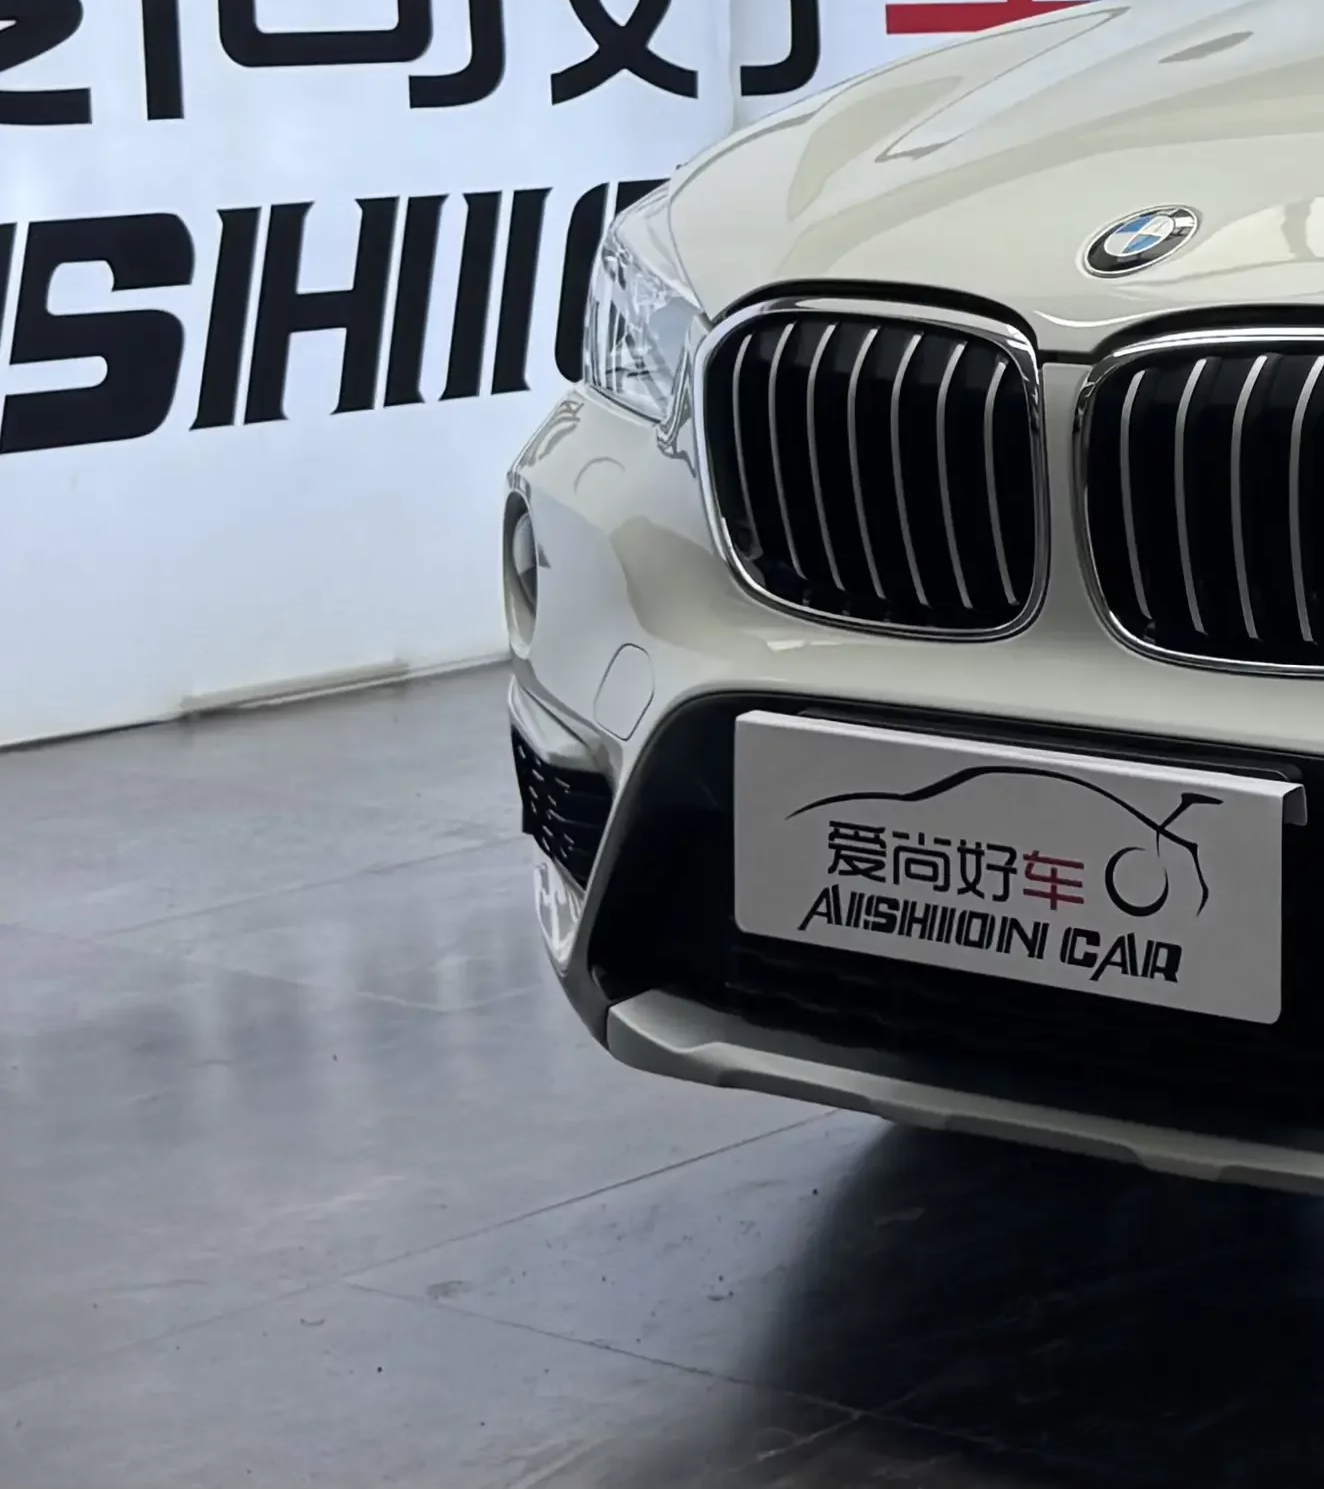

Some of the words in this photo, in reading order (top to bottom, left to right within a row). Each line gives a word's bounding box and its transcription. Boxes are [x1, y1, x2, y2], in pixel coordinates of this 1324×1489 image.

[827, 819, 1086, 912] 爱尚好车
[797, 883, 1050, 961] AISHION
[1059, 925, 1183, 984] CAR
